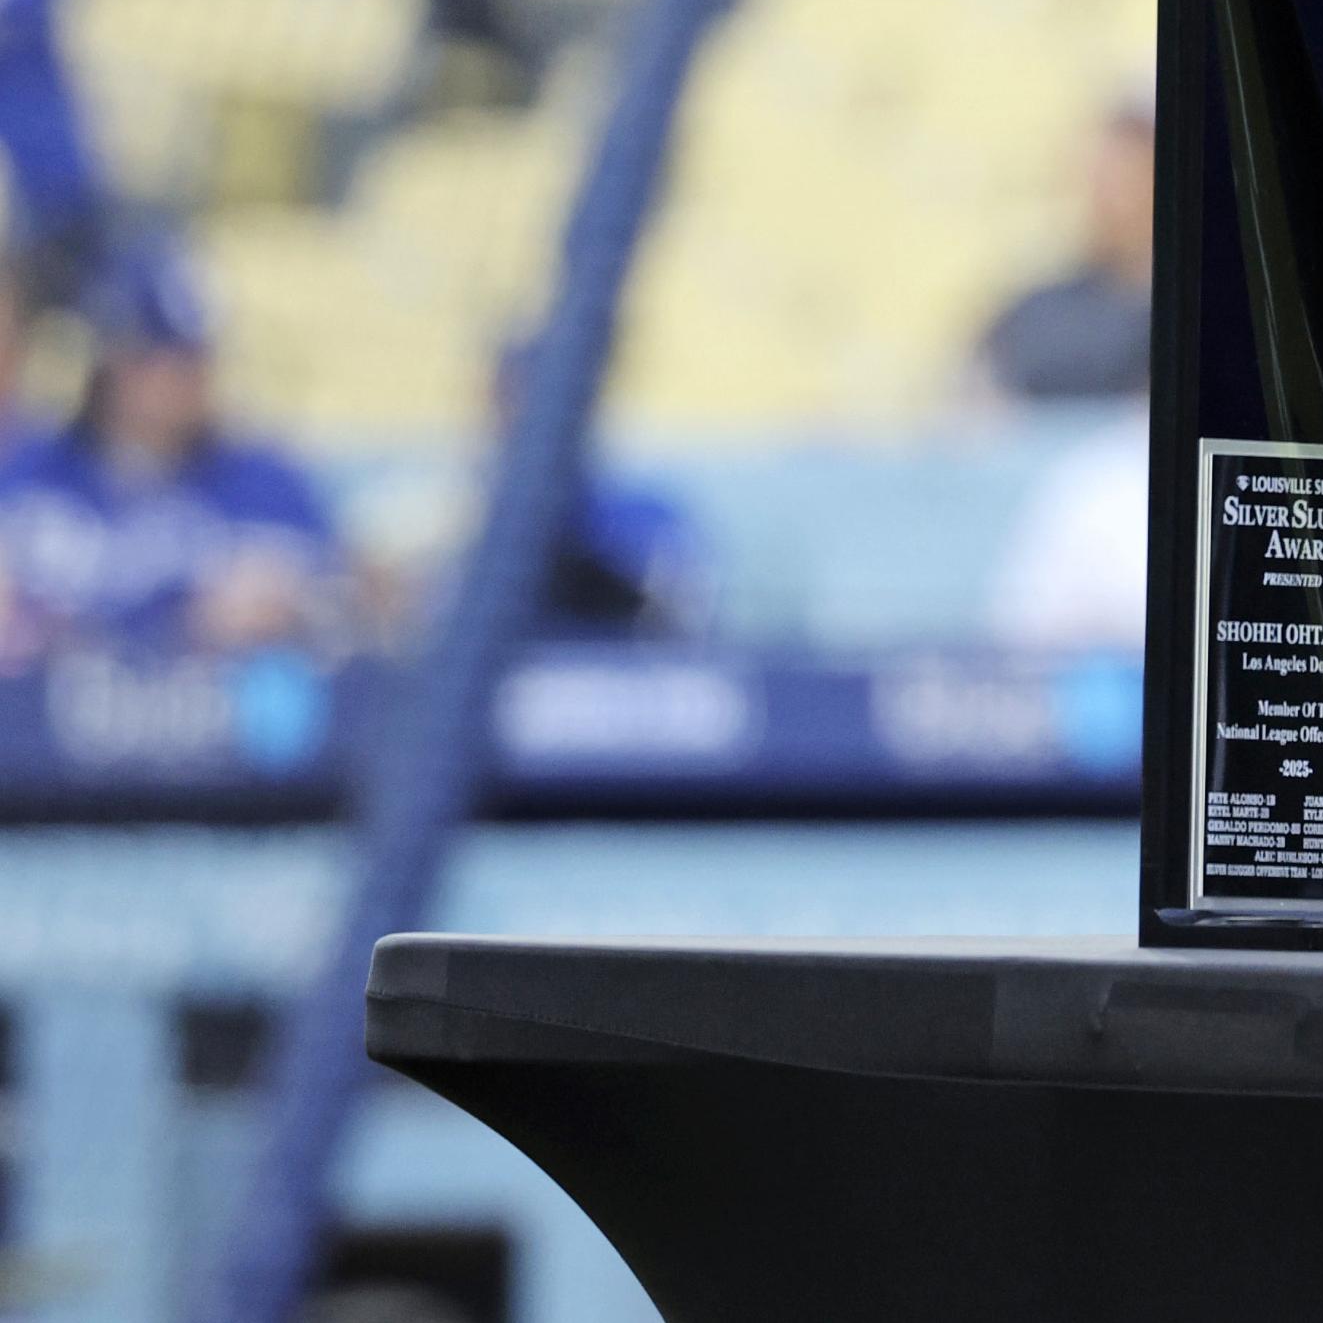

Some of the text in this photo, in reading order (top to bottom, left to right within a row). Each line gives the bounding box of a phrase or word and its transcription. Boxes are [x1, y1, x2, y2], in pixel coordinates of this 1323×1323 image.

[1252, 476, 1313, 494] LOUISVILLE
[1223, 496, 1289, 527] SILVER
[1263, 572, 1322, 587] PRESENTED
[1217, 620, 1282, 644] SHOHEI
[1242, 653, 1262, 670] Los
[1264, 654, 1307, 676] Angeles
[1258, 700, 1300, 717] Member
[1302, 702, 1318, 718] Of
[1217, 722, 1259, 740] National
[1261, 724, 1298, 746] League
[1279, 760, 1313, 777] -2025-
